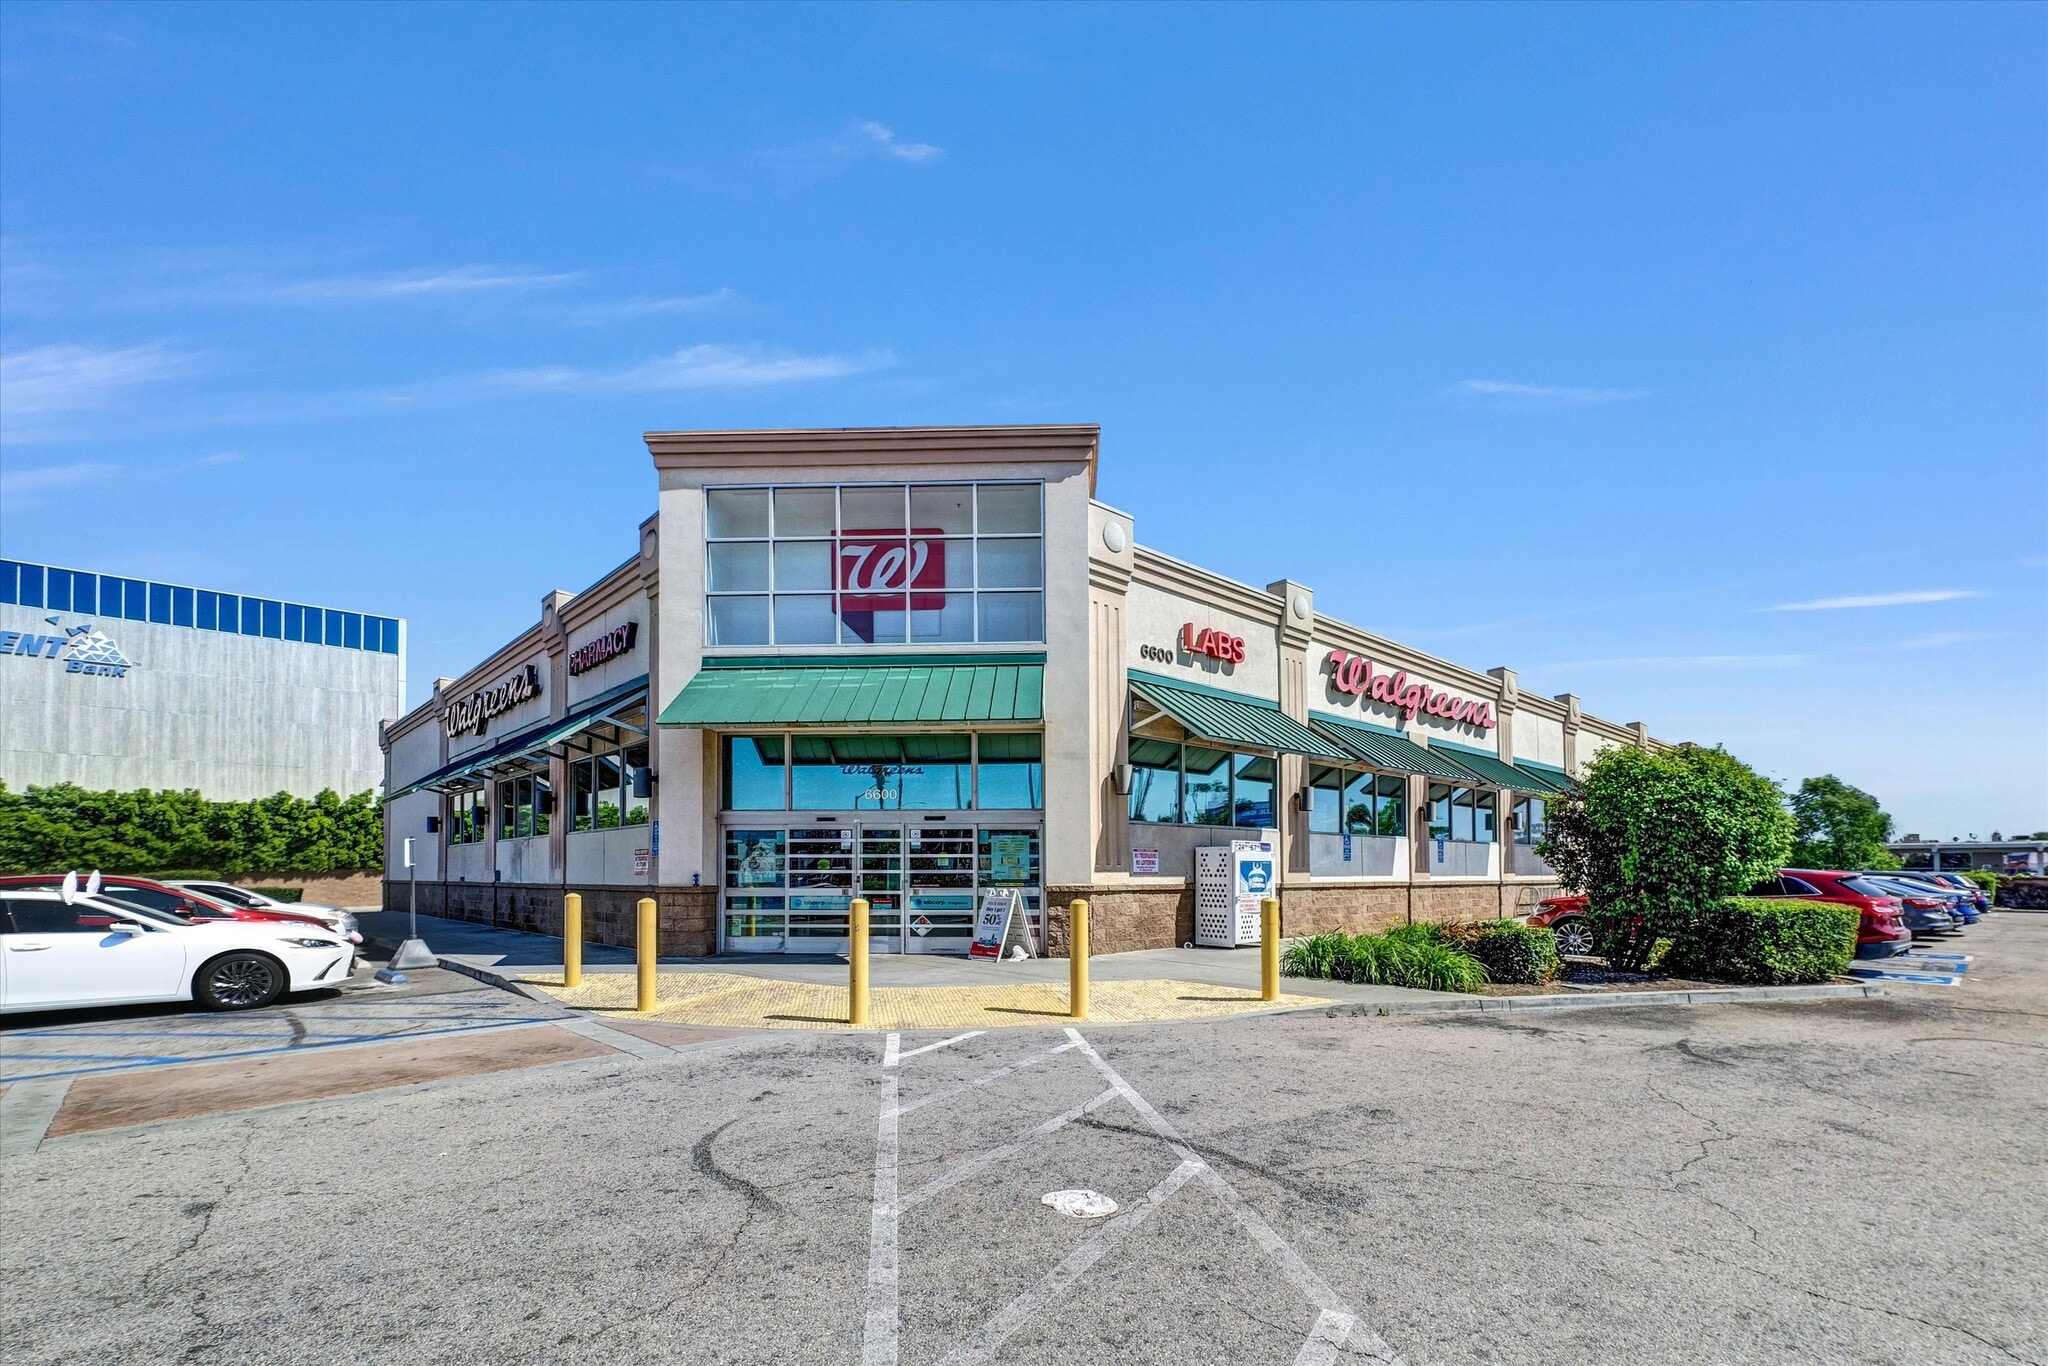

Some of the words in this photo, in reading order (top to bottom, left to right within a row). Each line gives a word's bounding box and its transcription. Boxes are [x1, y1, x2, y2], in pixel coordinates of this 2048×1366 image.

[569, 622, 638, 676] PHARMACY
[1140, 644, 1174, 665] 6600
[1183, 622, 1246, 664] LABS
[66, 660, 127, 678] Bank
[445, 664, 542, 738] Walgreens
[1330, 650, 1496, 729] Walgreens
[840, 764, 925, 778] Walgreens
[864, 789, 898, 800] 6600
